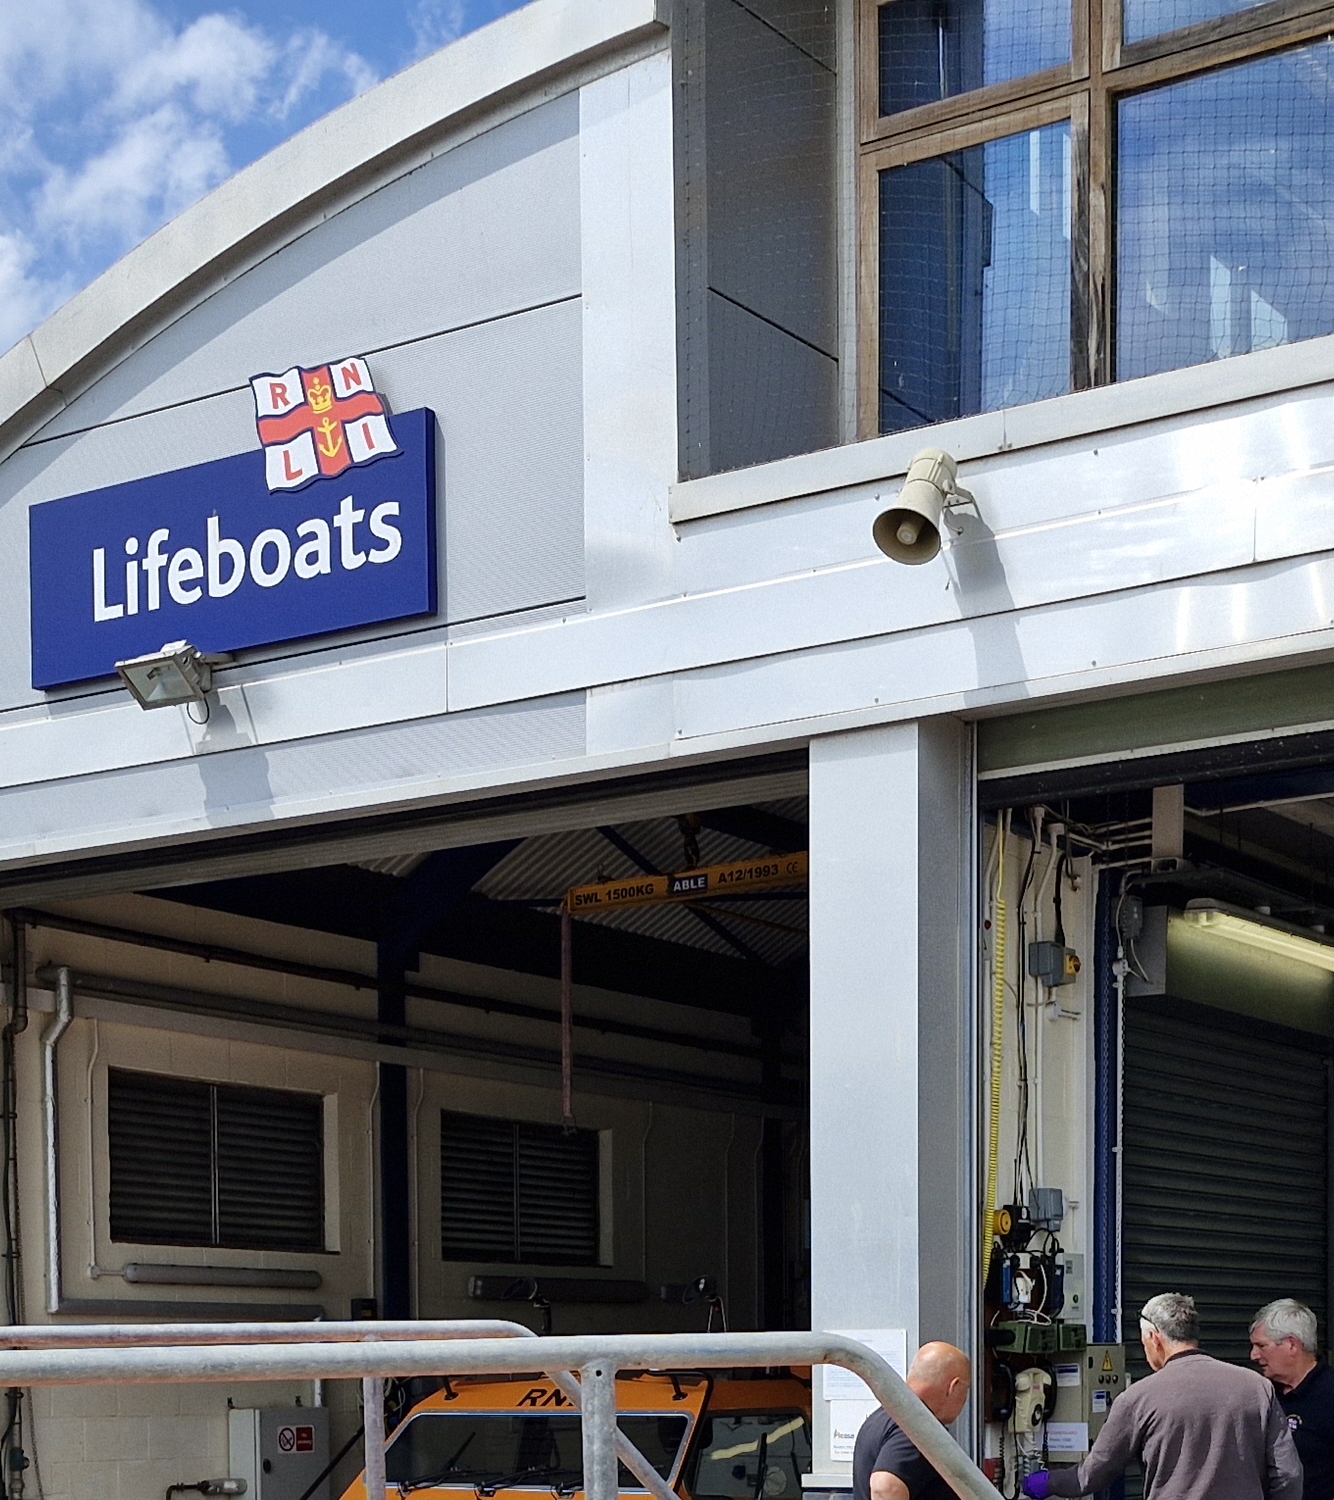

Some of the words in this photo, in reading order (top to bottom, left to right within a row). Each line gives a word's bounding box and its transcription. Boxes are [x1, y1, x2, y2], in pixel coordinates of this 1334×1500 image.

[92, 495, 403, 622] Lifeboats
[574, 890, 603, 906] SWL
[605, 883, 654, 902] 1500KG
[672, 876, 706, 892] ABLE
[717, 863, 779, 885] A12/1993
